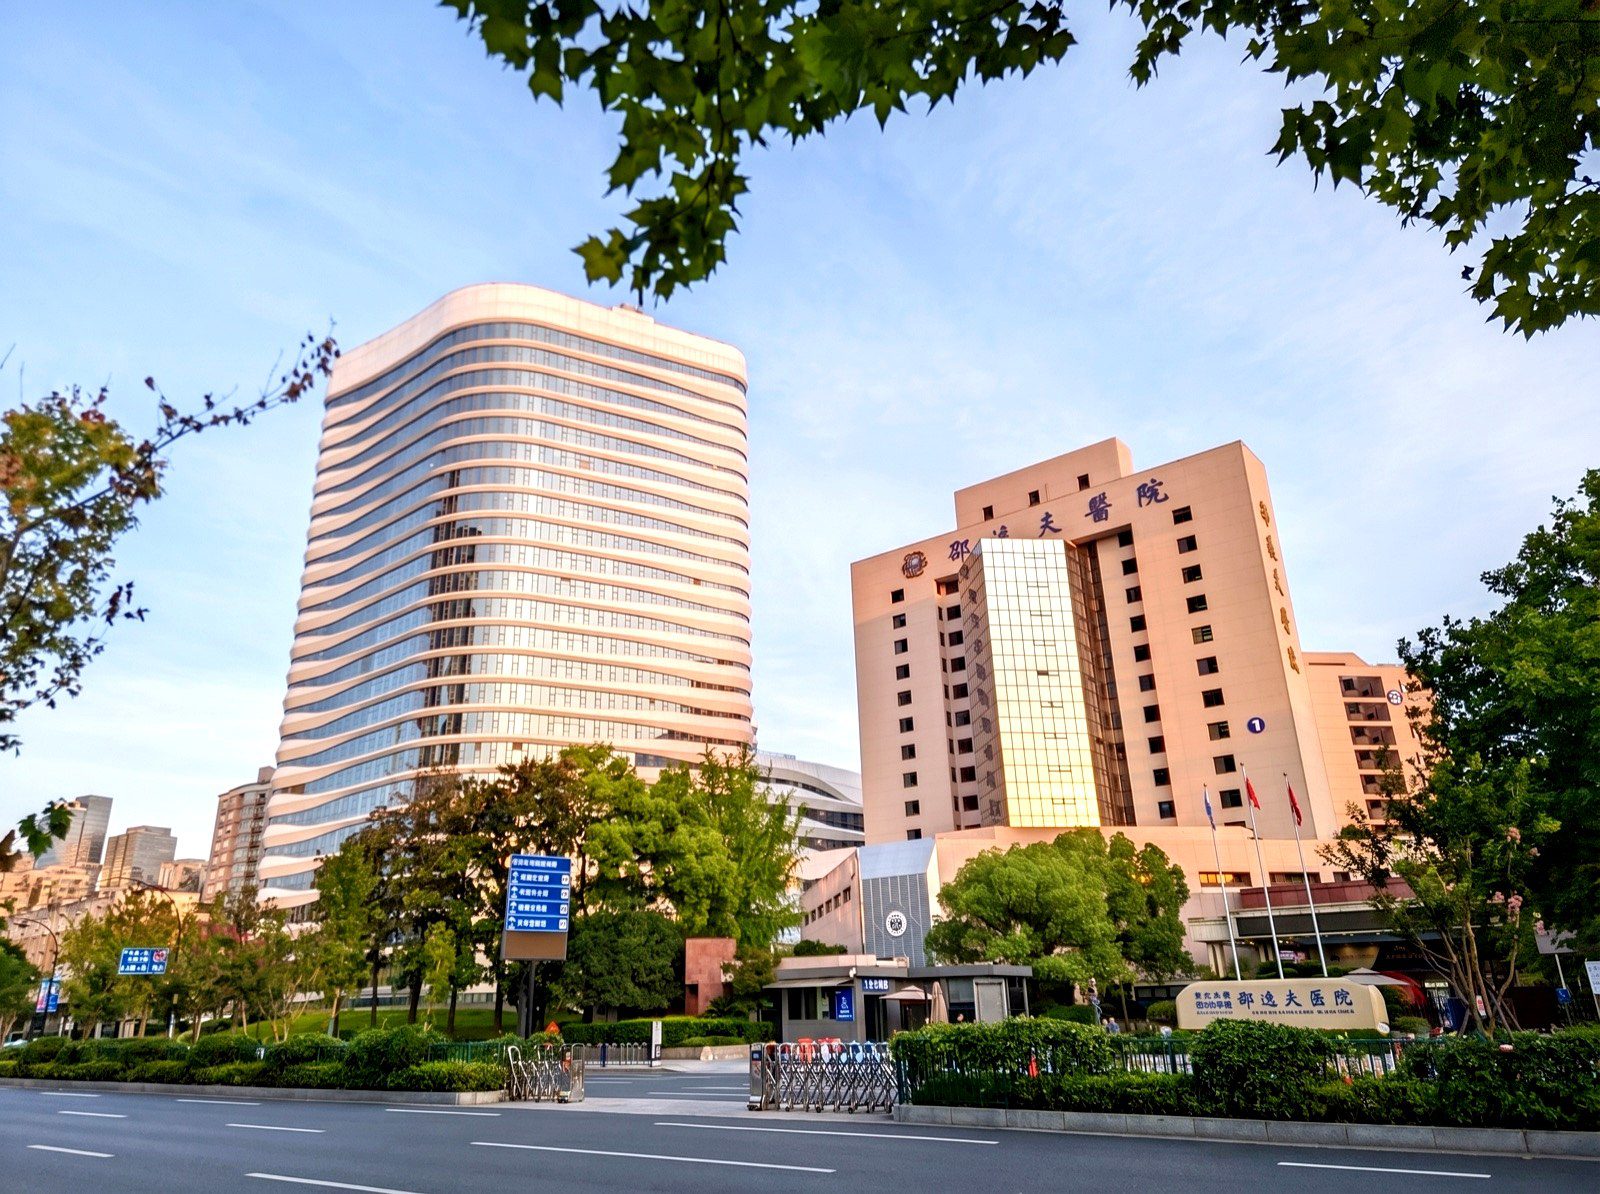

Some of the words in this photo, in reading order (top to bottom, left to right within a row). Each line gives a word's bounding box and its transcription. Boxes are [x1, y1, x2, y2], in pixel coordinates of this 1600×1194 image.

[1252, 719, 1261, 731] 1
[1237, 988, 1353, 1009] 邵逸夫医院
